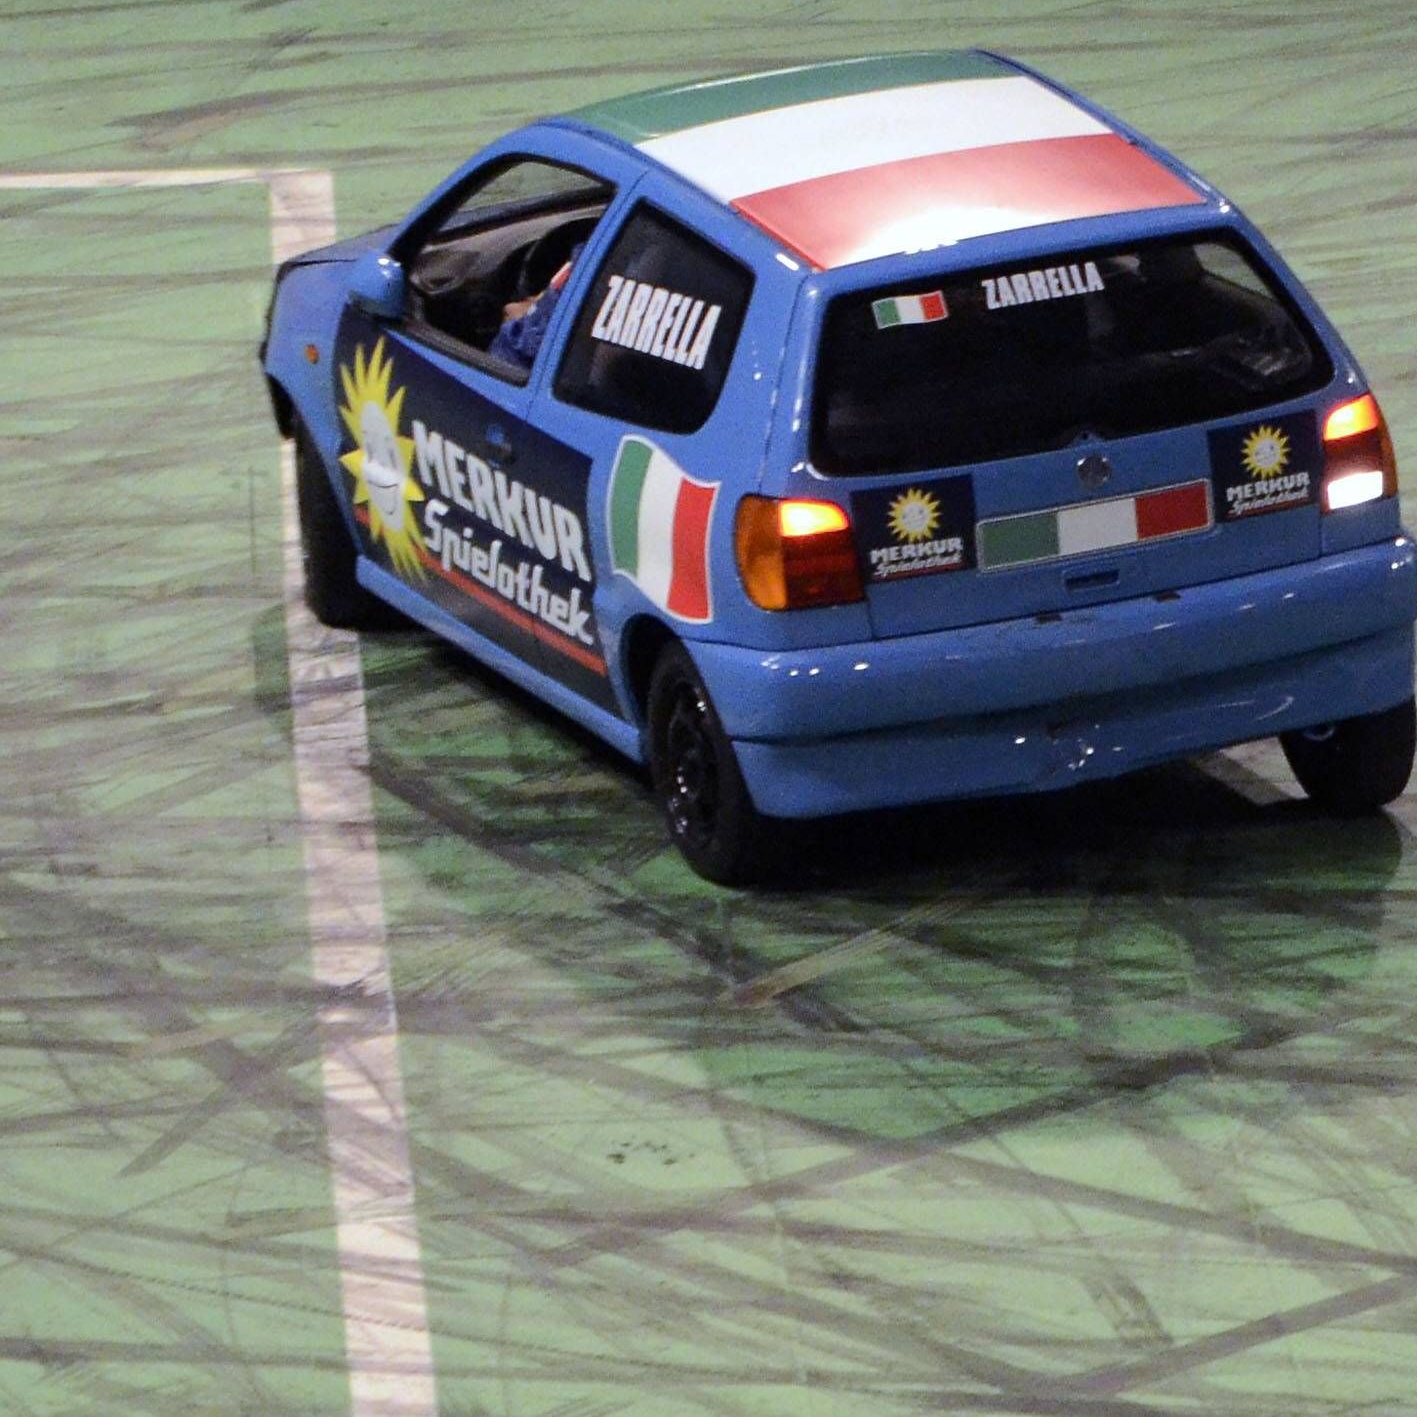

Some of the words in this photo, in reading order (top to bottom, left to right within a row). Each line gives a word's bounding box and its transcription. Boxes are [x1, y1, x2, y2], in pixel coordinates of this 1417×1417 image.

[980, 260, 1105, 310] ZARRELLA
[590, 274, 722, 371] ZARRELLA
[412, 419, 591, 583] MERKUR
[1226, 471, 1311, 502] MERKUR
[423, 502, 596, 647] Spielothek
[869, 536, 964, 565] MERKUR
